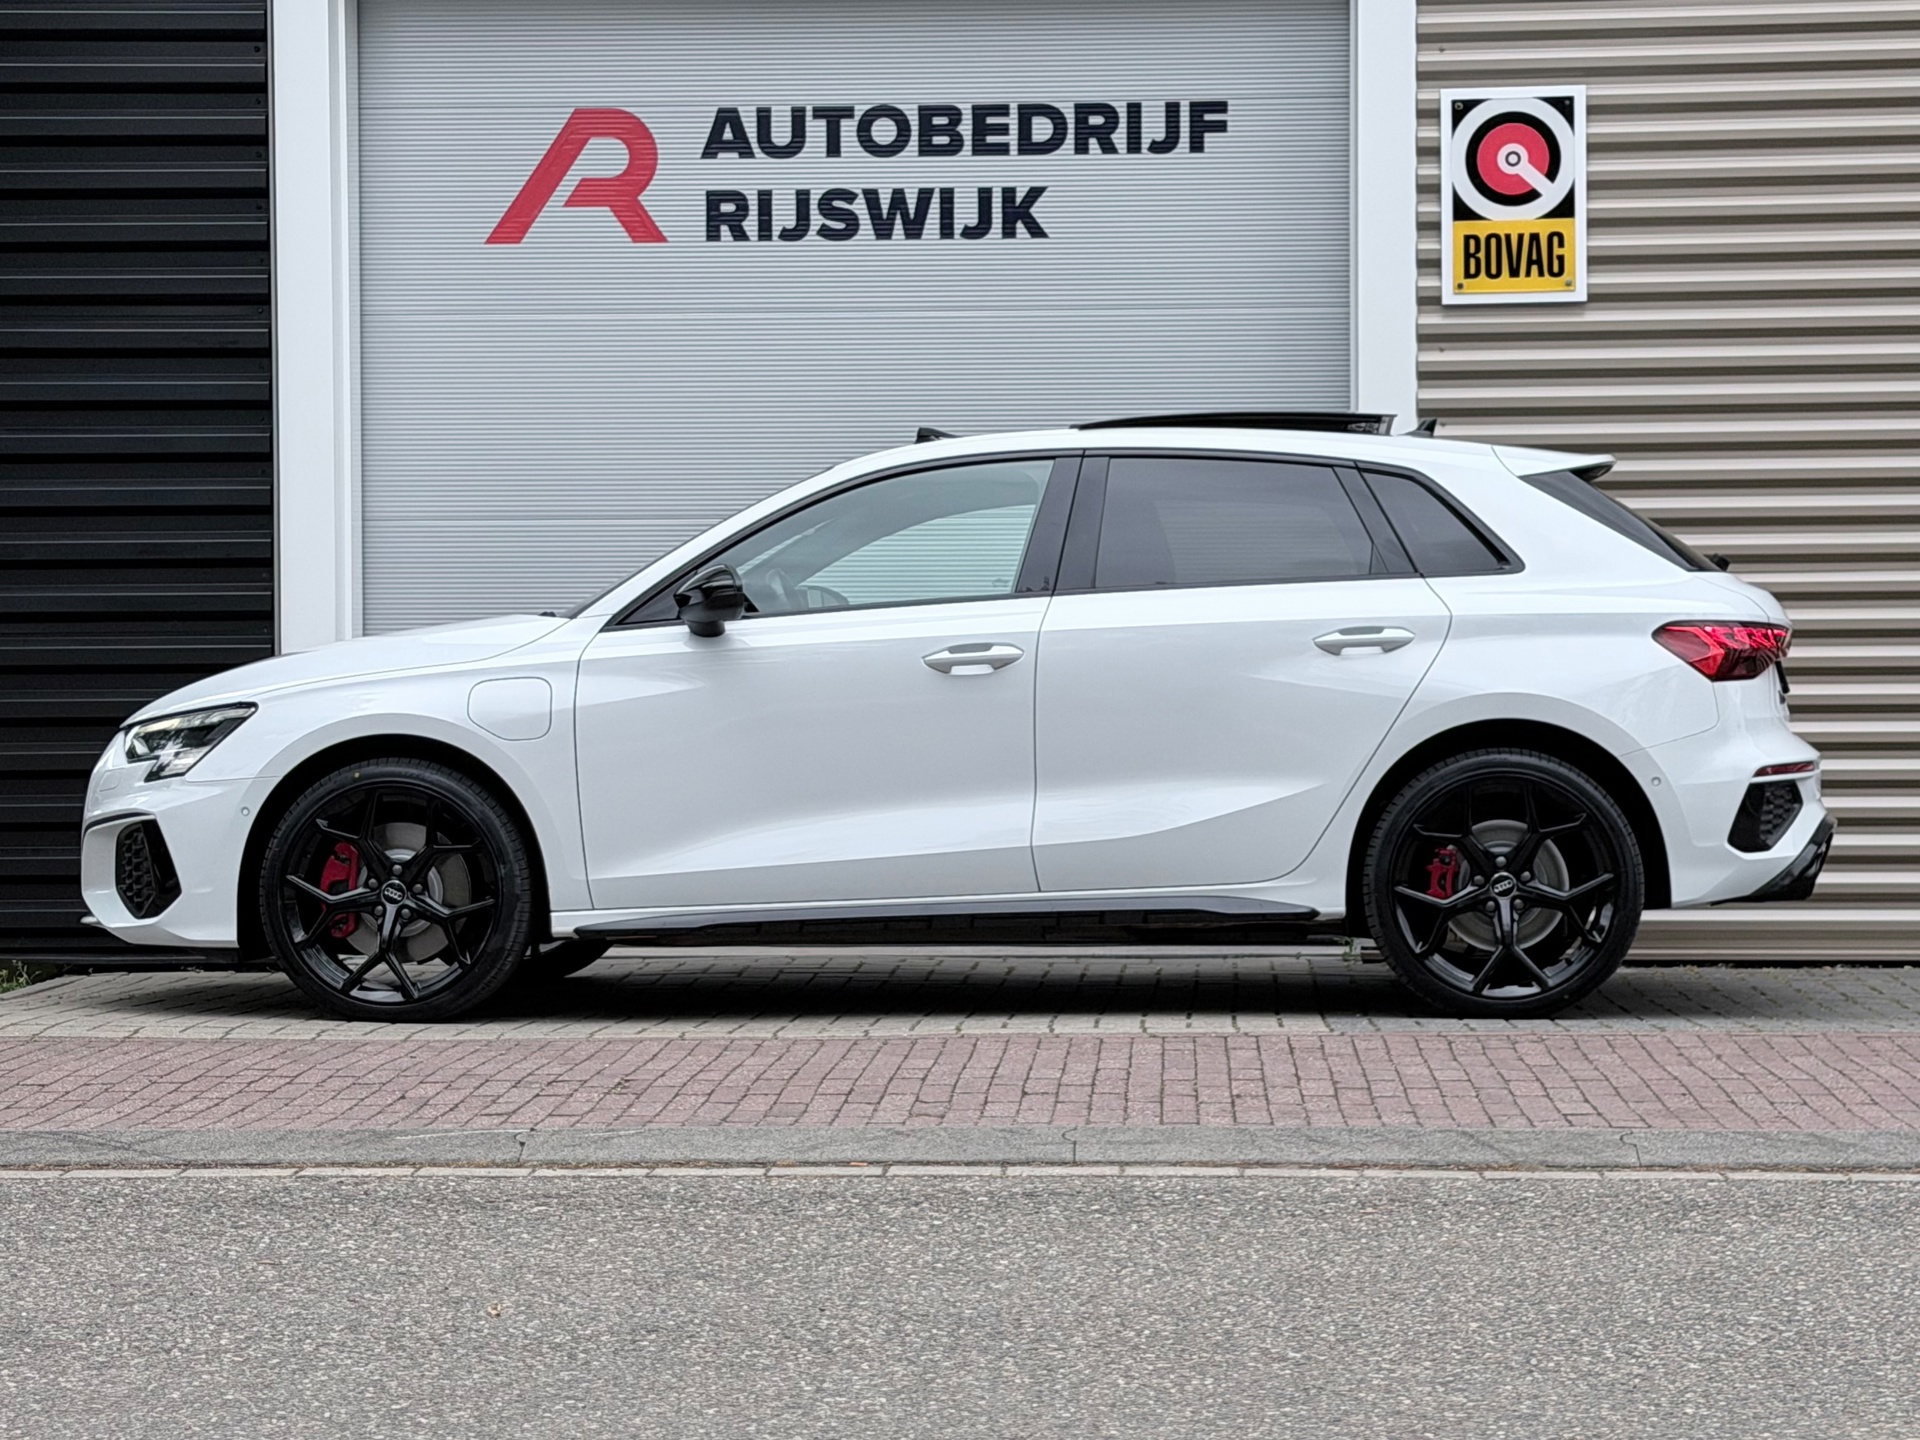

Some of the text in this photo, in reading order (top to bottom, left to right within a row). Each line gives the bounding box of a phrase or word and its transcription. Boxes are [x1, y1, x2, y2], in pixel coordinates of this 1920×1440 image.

[701, 101, 1228, 159] AUTOBEDRIJF
[705, 187, 1050, 241] RIJSWIJK
[1463, 231, 1565, 280] BOVAG
